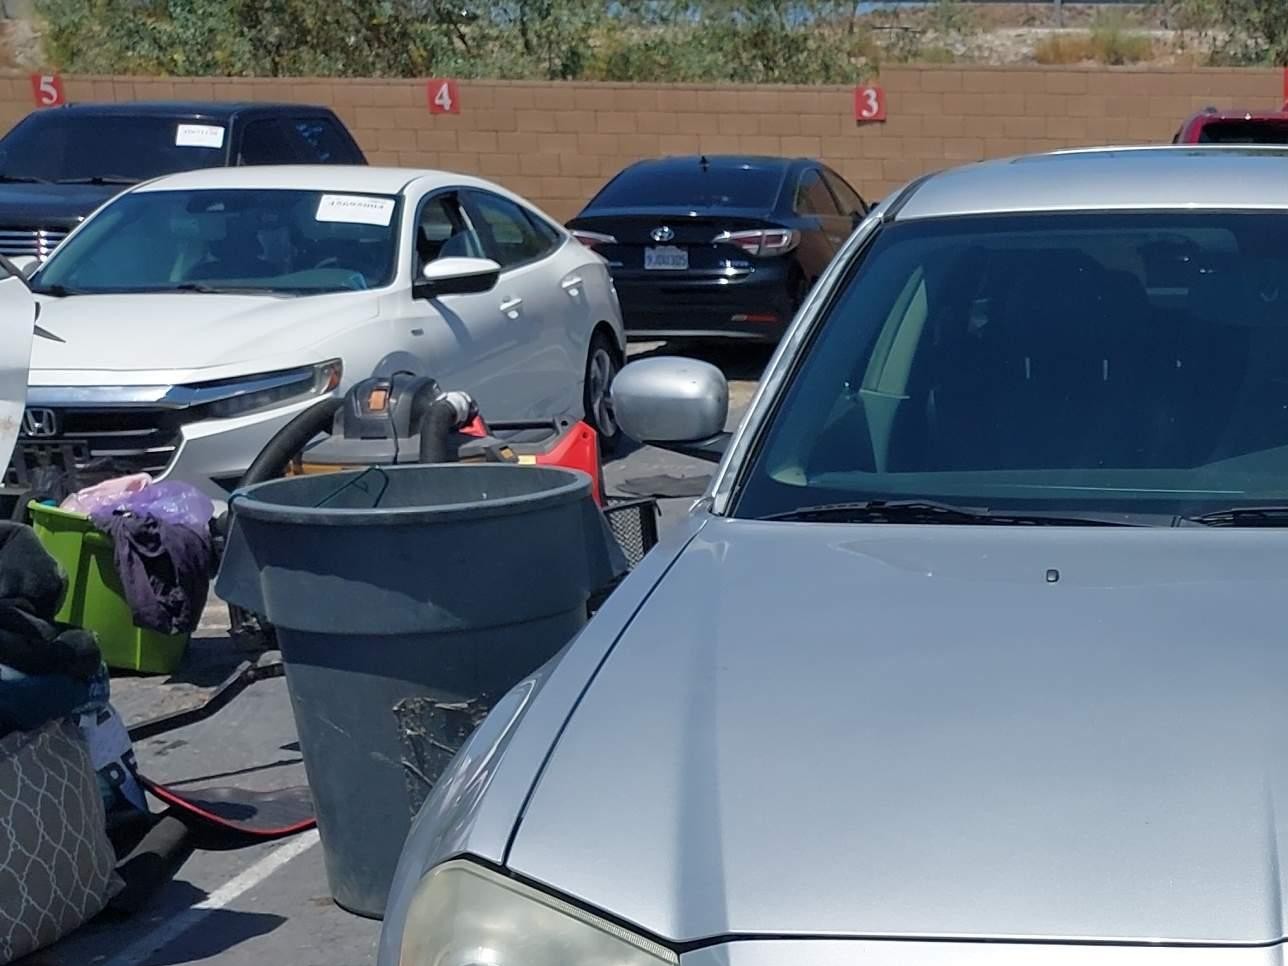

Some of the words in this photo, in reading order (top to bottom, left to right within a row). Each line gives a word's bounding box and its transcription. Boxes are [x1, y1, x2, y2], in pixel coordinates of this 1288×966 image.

[39, 76, 57, 104] 5
[434, 82, 452, 110] 4
[861, 88, 879, 117] 3
